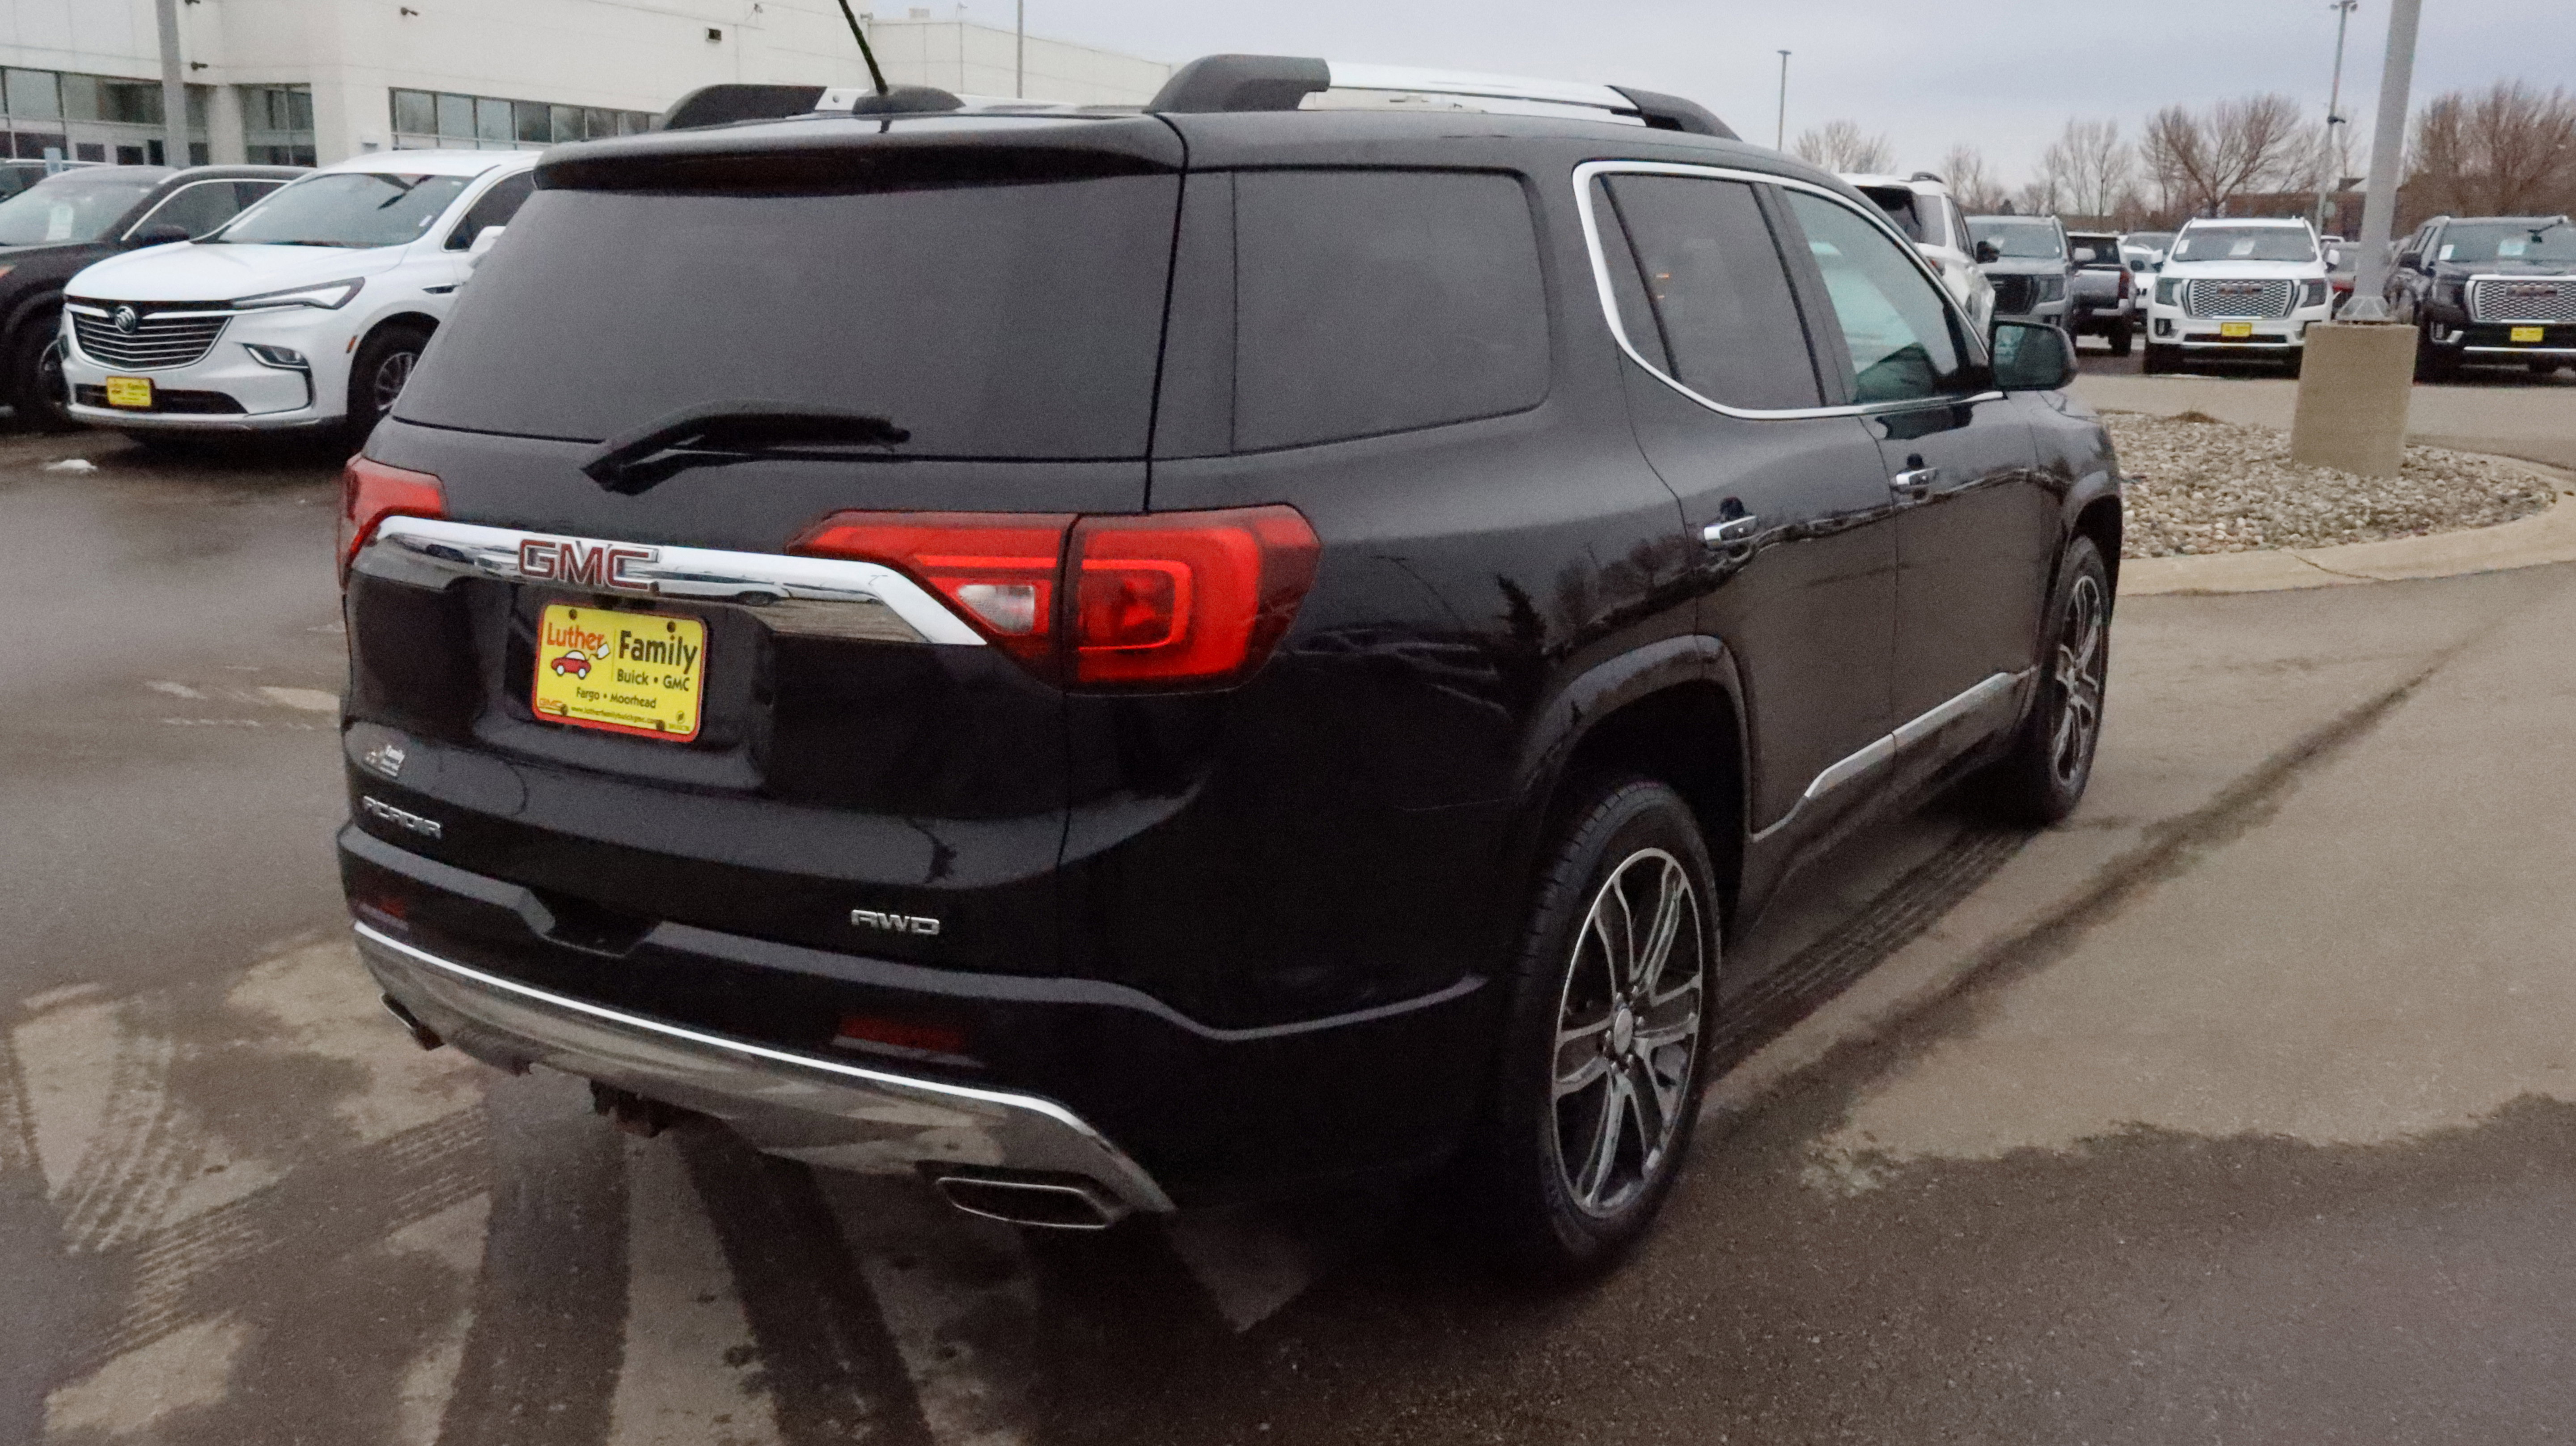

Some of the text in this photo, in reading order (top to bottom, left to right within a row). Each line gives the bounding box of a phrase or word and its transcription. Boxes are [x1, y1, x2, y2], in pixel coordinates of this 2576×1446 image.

[519, 539, 653, 591] GMC
[547, 622, 604, 650] Luther
[619, 630, 698, 675] Family
[617, 668, 690, 691] Buick GMC
[576, 686, 657, 708] Fargo Moorhead
[363, 795, 441, 840] ACADIA
[851, 909, 940, 935] AWD
